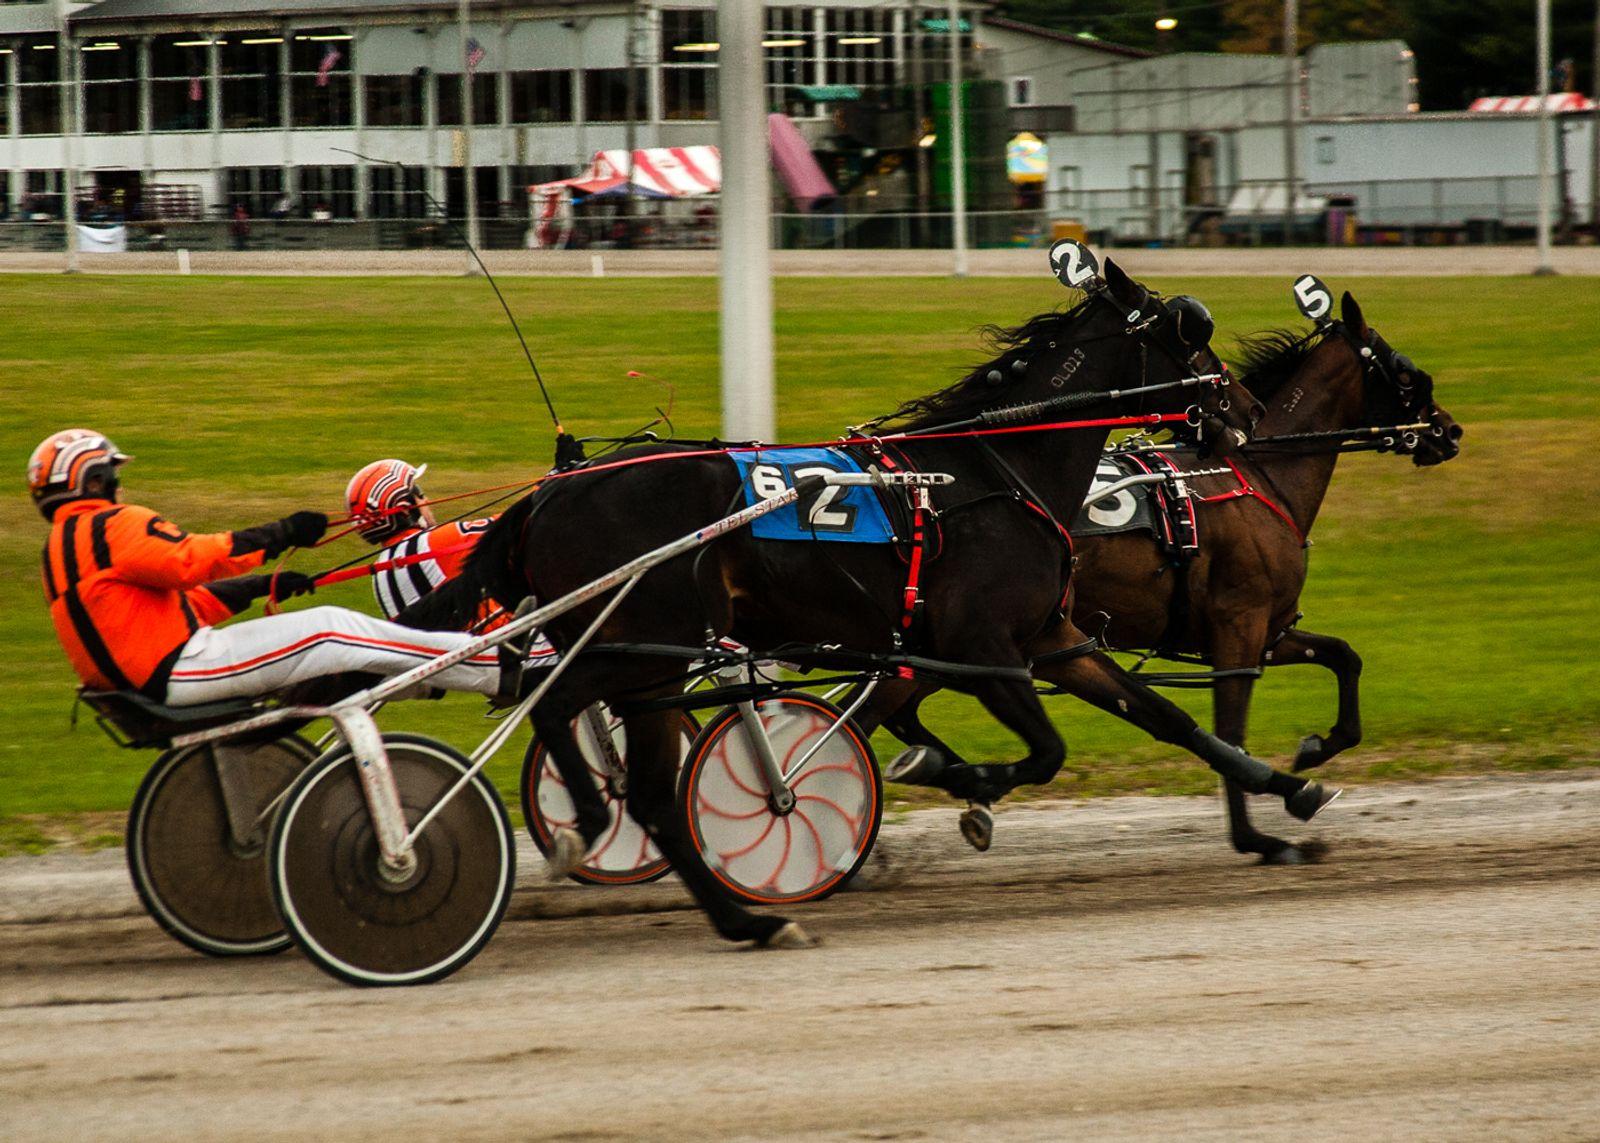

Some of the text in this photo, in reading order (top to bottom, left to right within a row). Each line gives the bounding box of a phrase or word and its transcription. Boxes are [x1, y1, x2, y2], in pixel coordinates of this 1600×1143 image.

[1051, 243, 1094, 285] 2
[1294, 275, 1330, 318] 5
[752, 465, 848, 526] 6 2
[1088, 465, 1137, 527] 5
